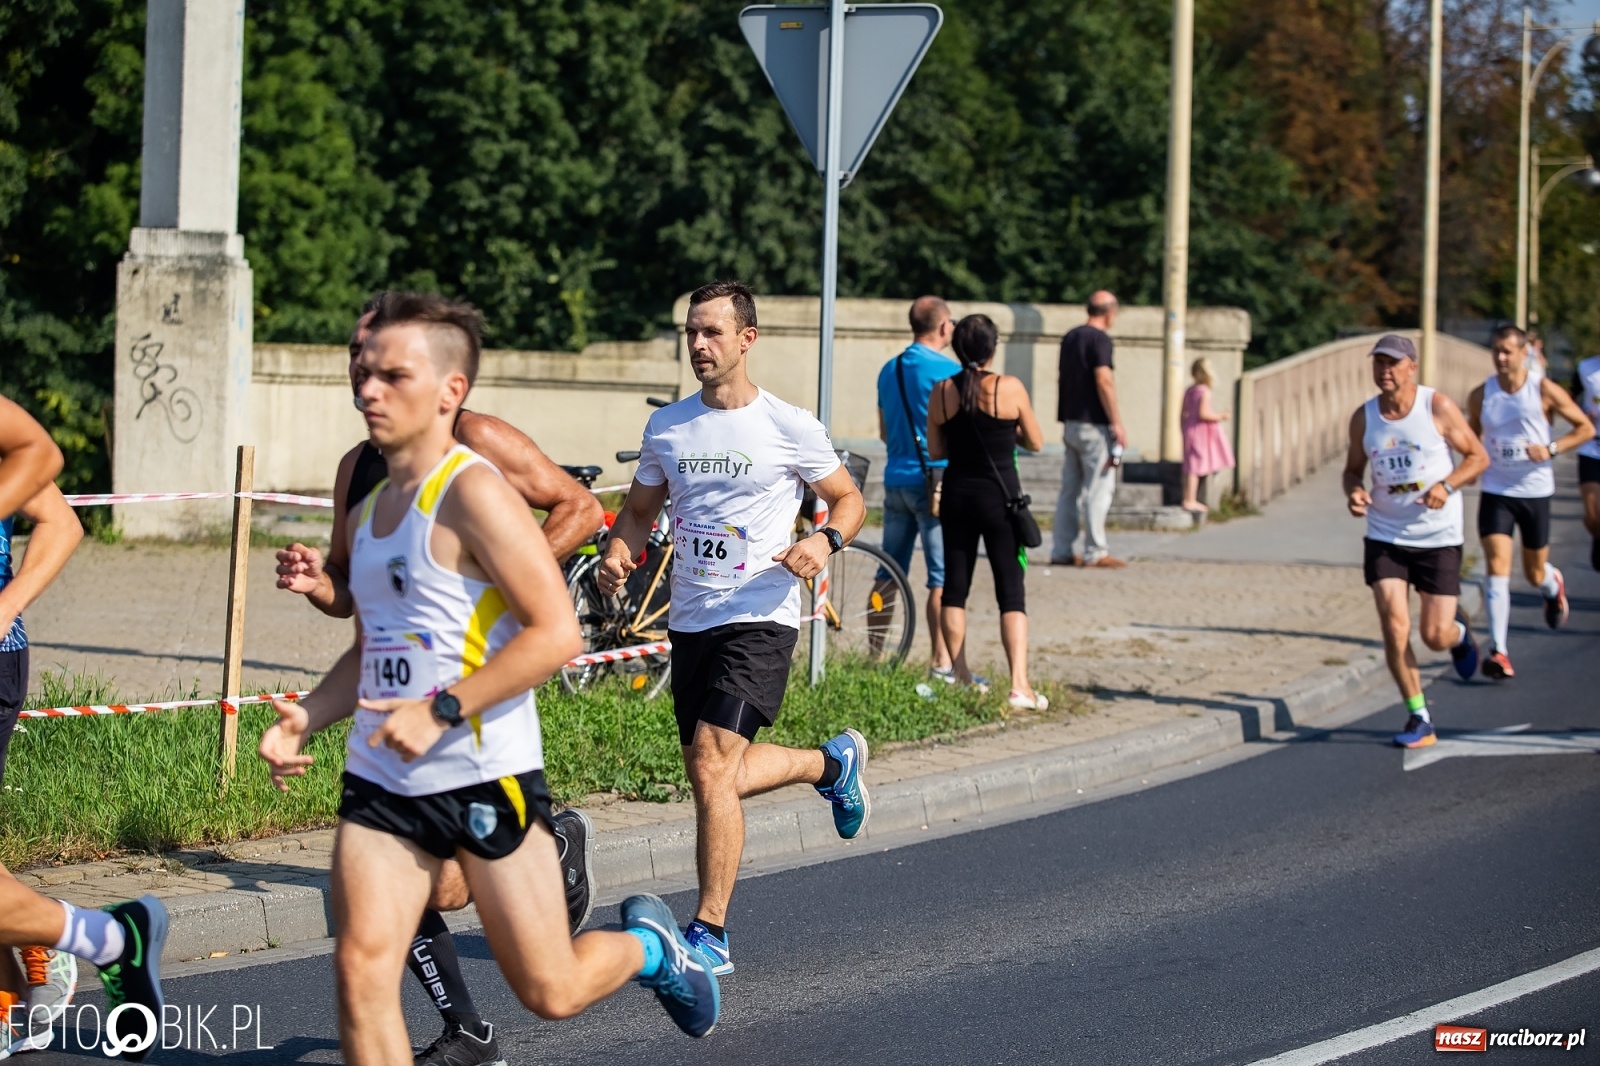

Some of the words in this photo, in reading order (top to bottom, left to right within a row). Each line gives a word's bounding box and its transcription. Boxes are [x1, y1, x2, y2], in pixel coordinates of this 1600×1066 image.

[681, 451, 724, 459] team
[1388, 455, 1412, 470] 316
[677, 456, 753, 478] eventyr
[692, 537, 728, 560] 126
[374, 656, 411, 688] 140
